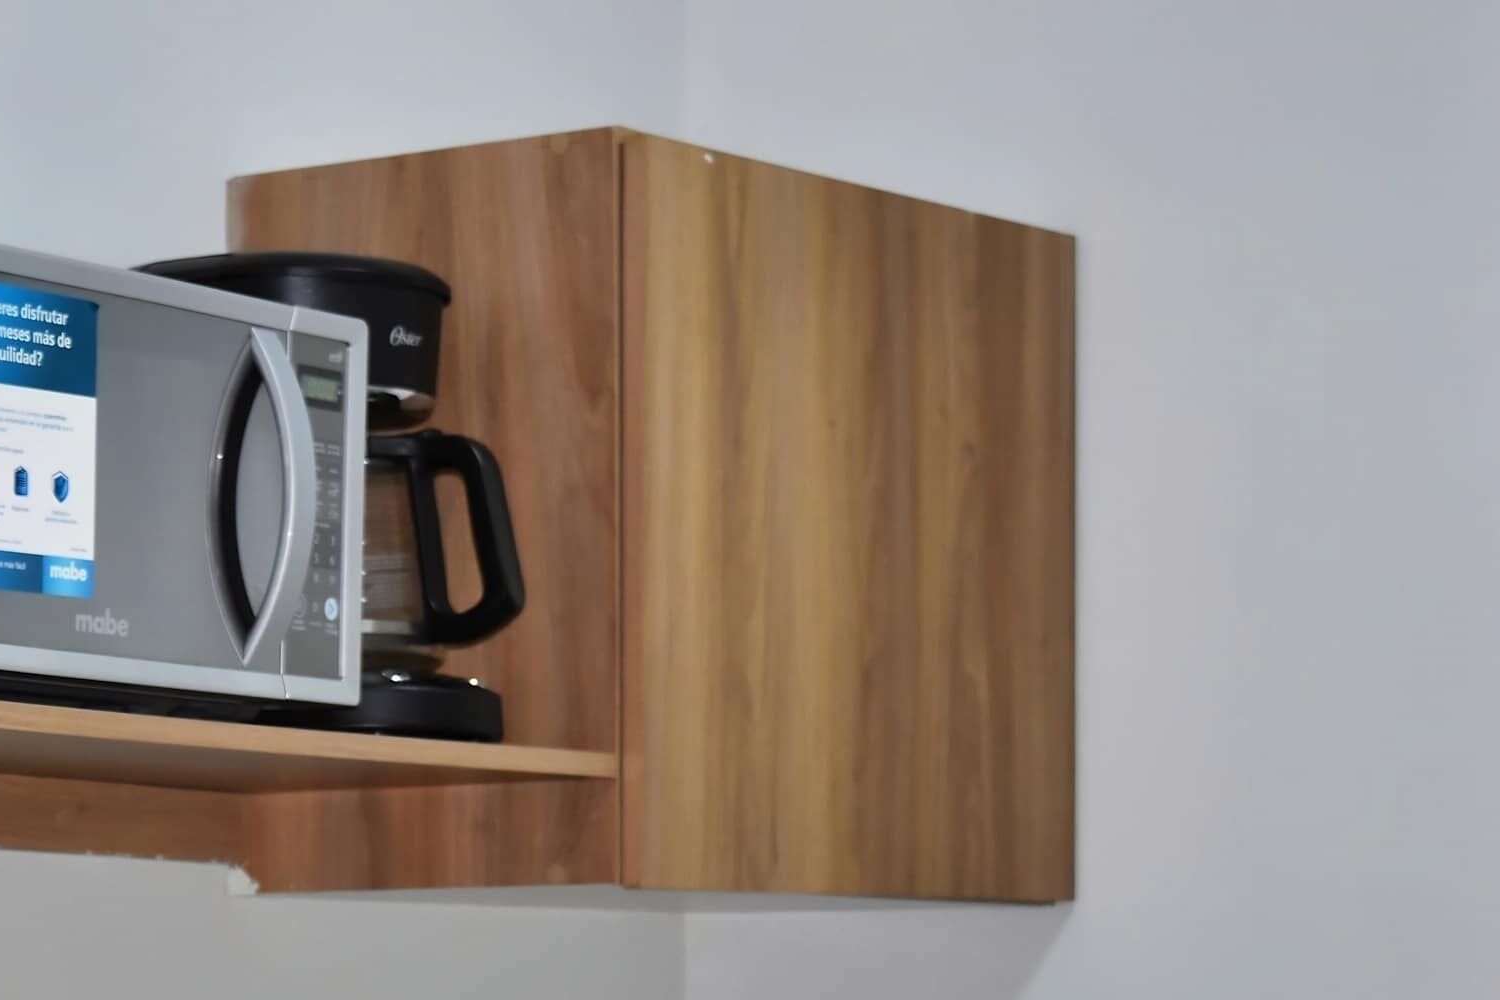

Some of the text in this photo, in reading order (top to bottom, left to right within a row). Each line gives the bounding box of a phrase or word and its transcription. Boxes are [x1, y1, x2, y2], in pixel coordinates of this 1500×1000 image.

[21, 303, 69, 326] disfrutar
[32, 329, 55, 347] más
[57, 334, 72, 349] de
[50, 561, 88, 581] mabe
[75, 608, 129, 637] mabe
